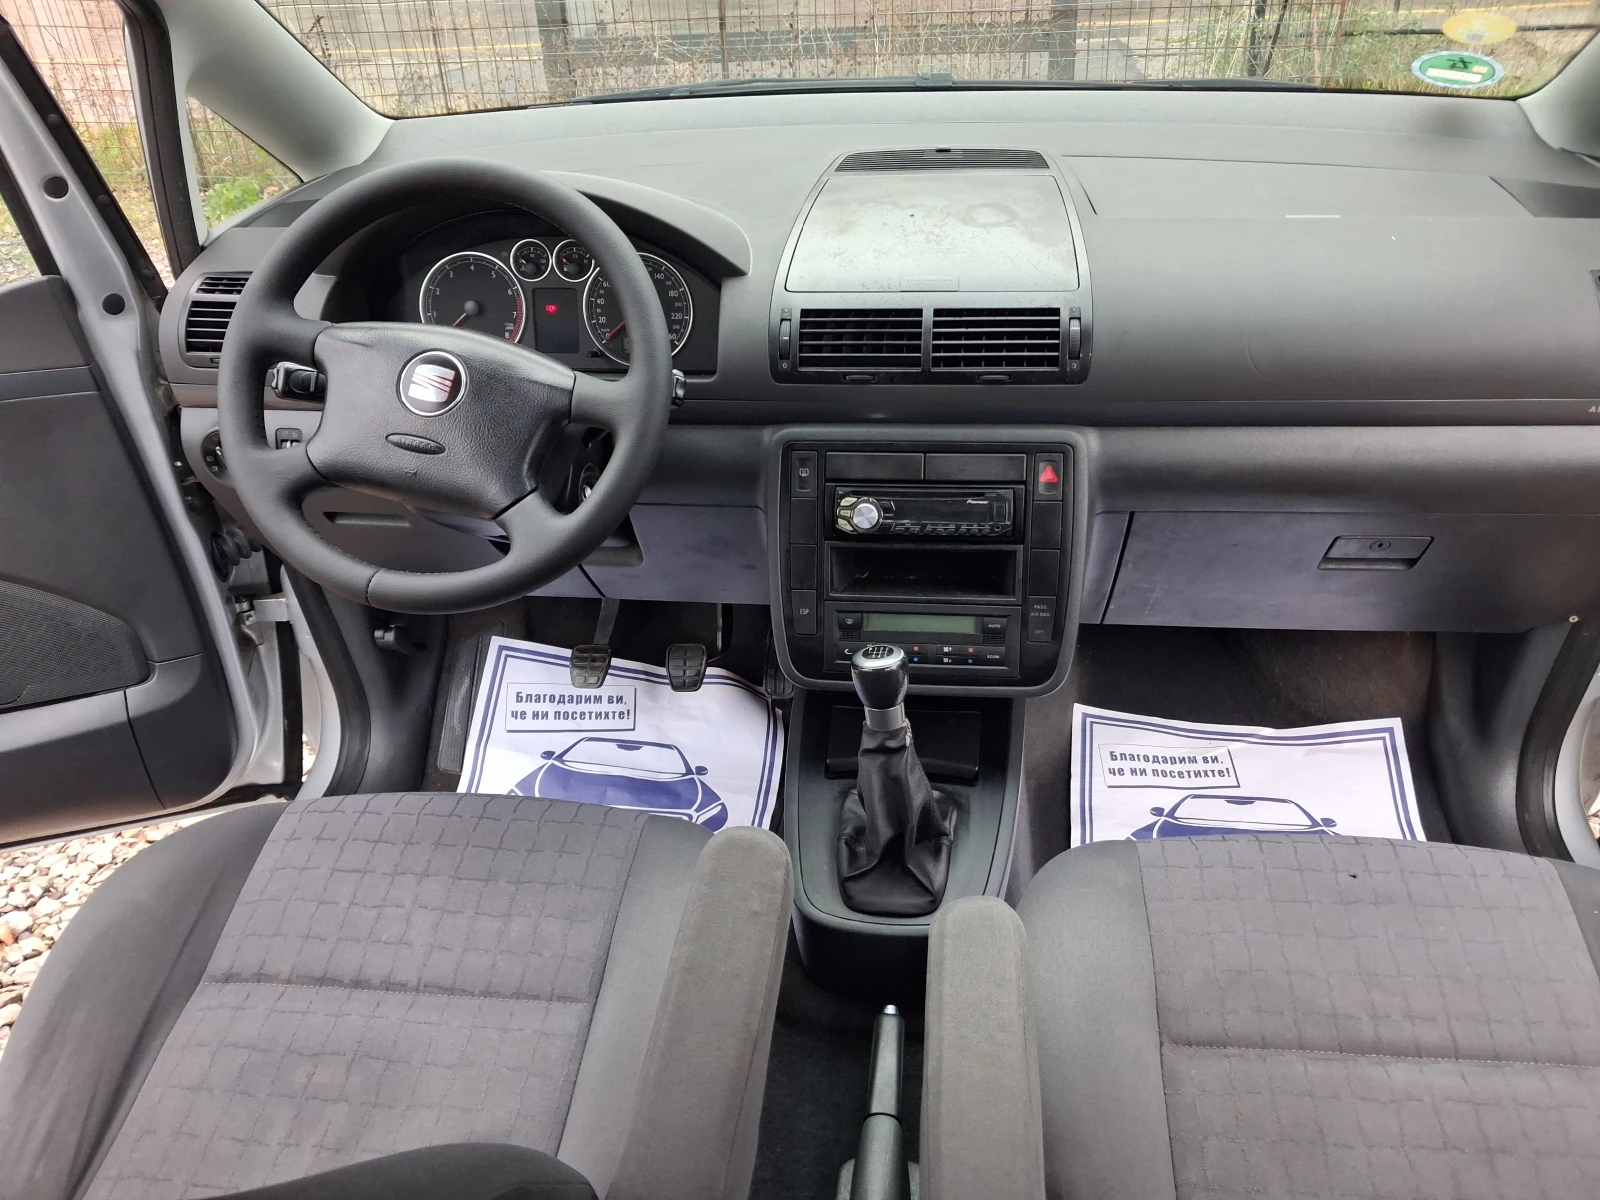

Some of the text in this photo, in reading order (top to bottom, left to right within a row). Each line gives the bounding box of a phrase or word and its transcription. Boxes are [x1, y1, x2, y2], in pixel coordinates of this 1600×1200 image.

[515, 691, 628, 706] Благодарим ви,
[510, 708, 631, 721] че ни посетихте!
[1109, 751, 1198, 766] Благодарим
[1108, 767, 1232, 780] че ни посетихте!
